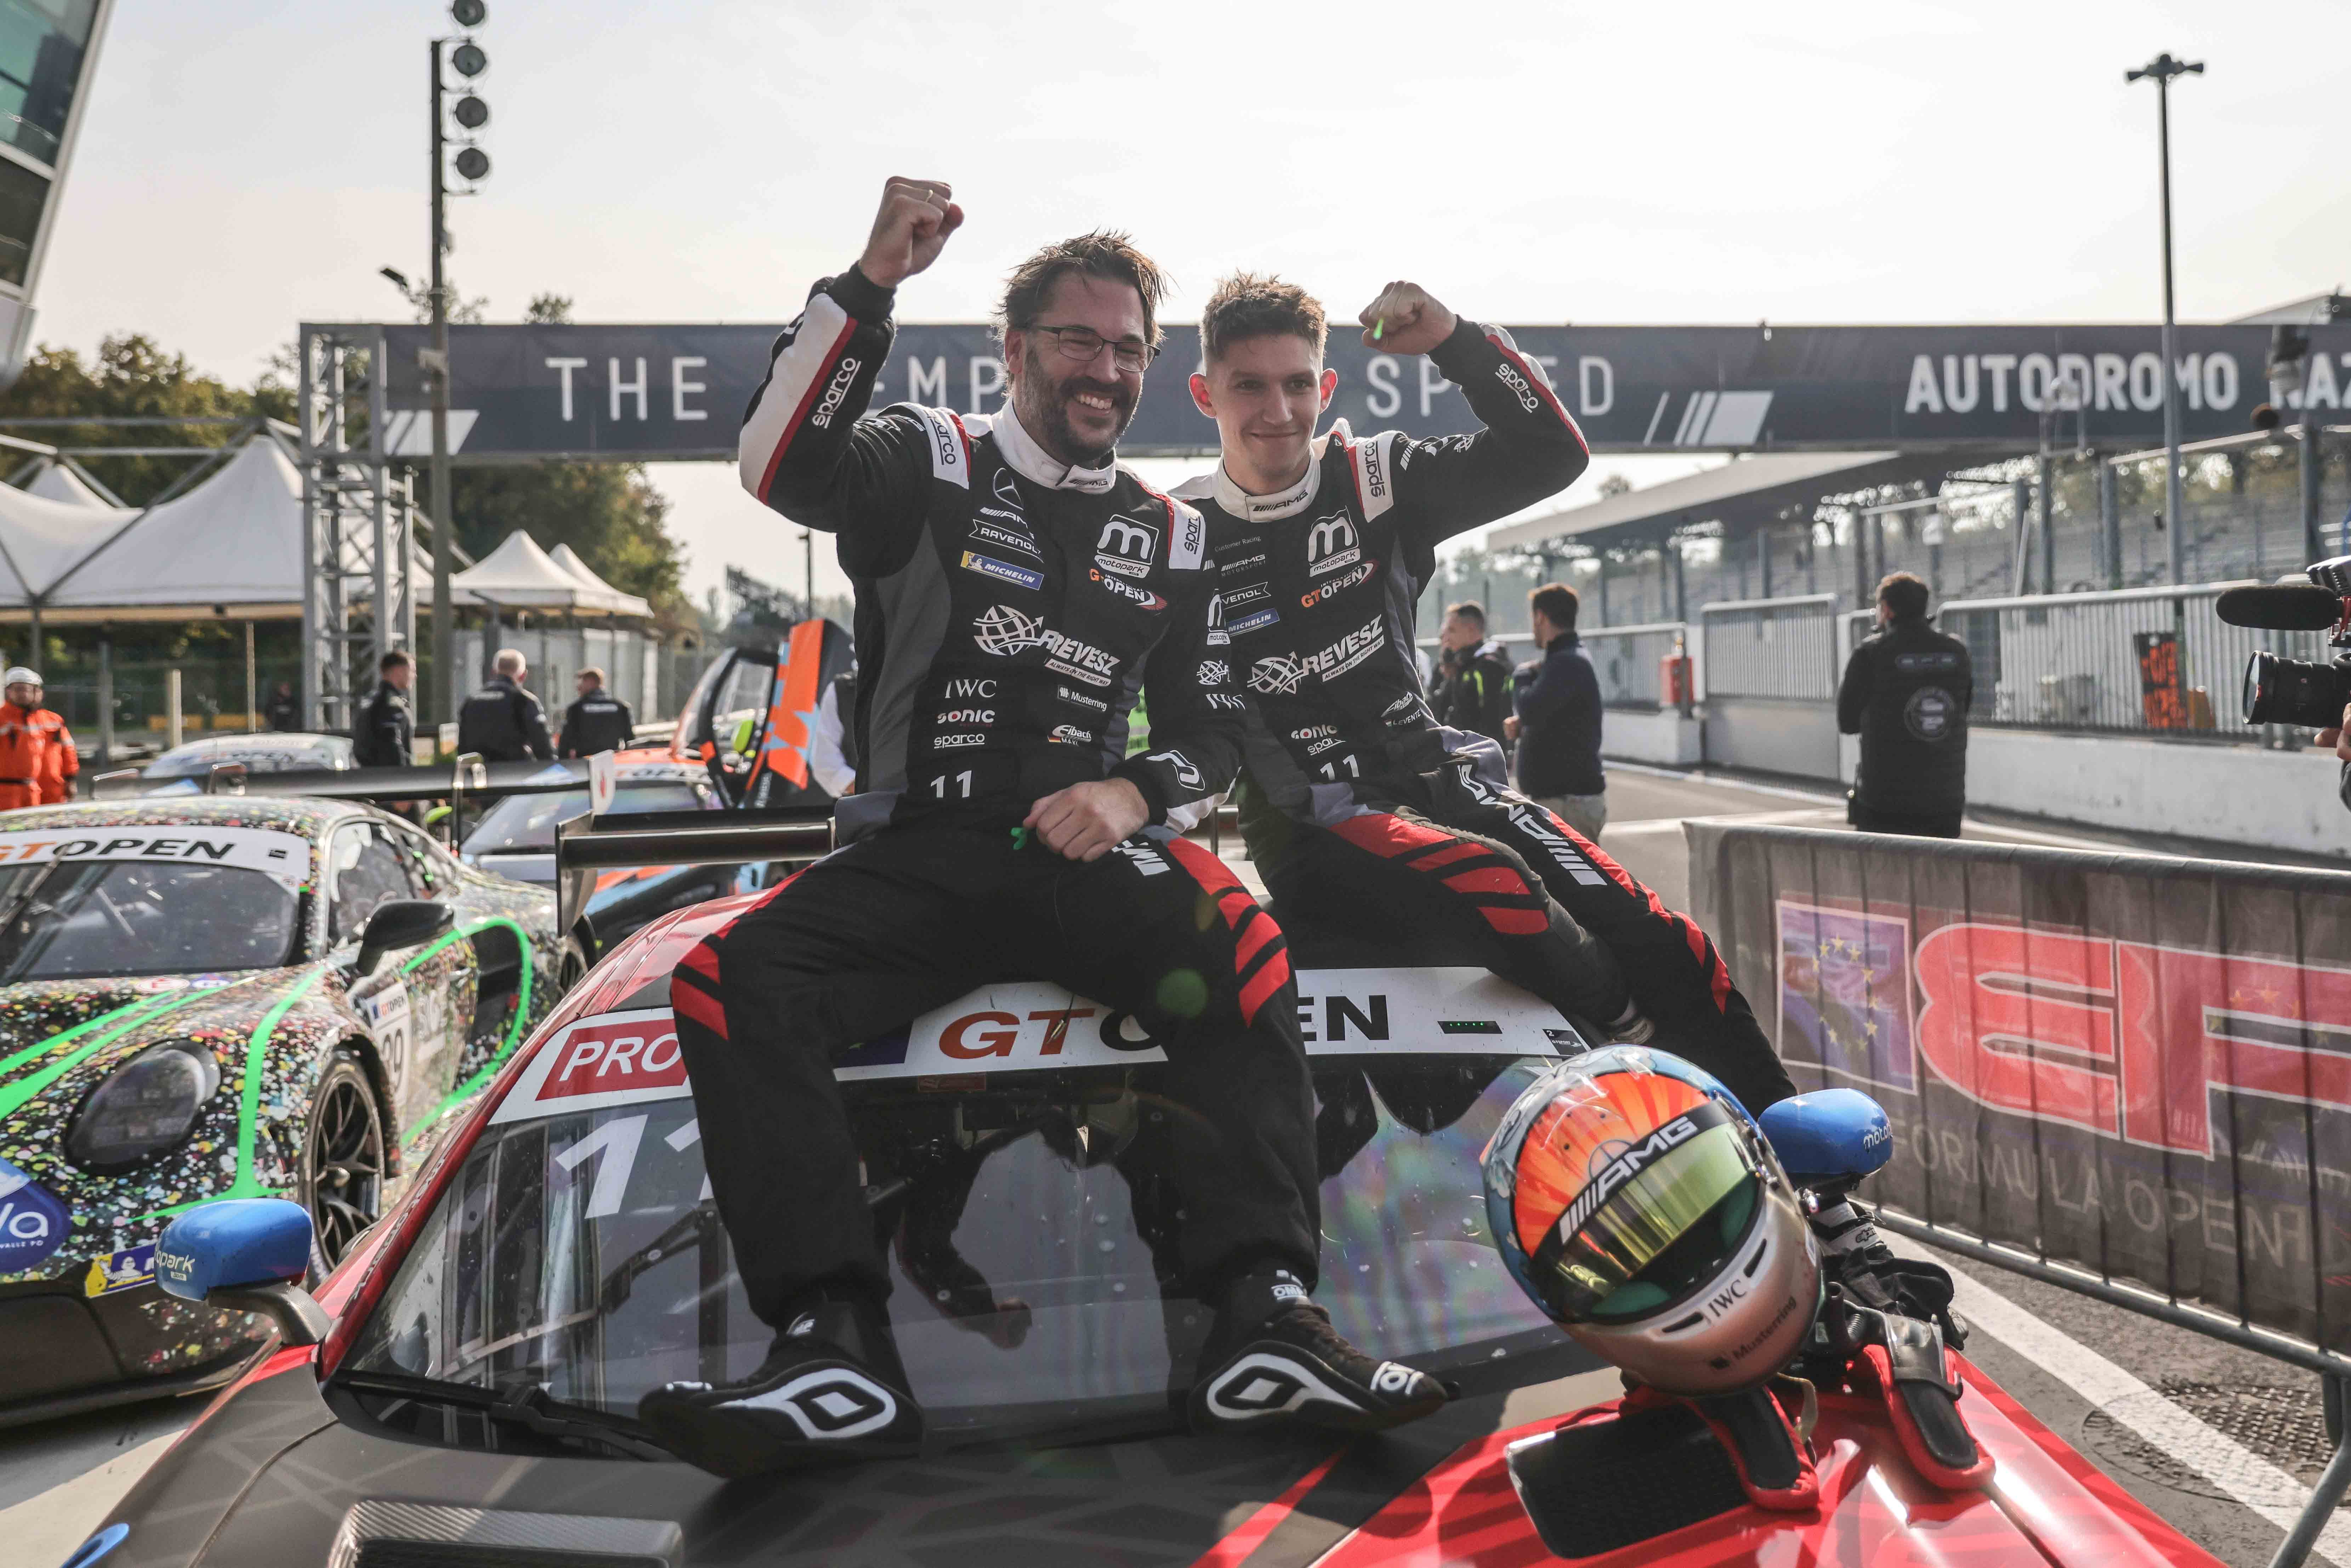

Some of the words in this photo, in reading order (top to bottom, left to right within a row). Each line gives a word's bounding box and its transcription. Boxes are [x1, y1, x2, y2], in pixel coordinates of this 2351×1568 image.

[545, 356, 709, 421] THE
[812, 358, 861, 429] sparco
[1906, 353, 2238, 413] AUTODROMO
[1364, 442, 1386, 497] sparco
[1274, 490, 1310, 510] AMG
[981, 527, 1038, 554] RAVENOL
[1184, 515, 1201, 555] spar
[1215, 541, 1241, 552] Customer
[1242, 536, 1261, 544] Racing
[984, 563, 1035, 583] MICHELIN
[1098, 558, 1145, 573] motopark
[1236, 554, 1266, 567] AMG
[1314, 551, 1356, 572] motopark
[1222, 589, 1261, 604] VENOL
[1301, 568, 1363, 608] GTOPEN
[1228, 614, 1271, 632] MICHELIN
[1042, 629, 1120, 676] REVESZ
[1302, 614, 1383, 675] REVESZ
[1324, 666, 1345, 680] ALWAYS
[1352, 655, 1361, 664] THE
[1360, 646, 1373, 659] RIGHT
[1373, 639, 1383, 651] WAY
[1049, 661, 1070, 672] ALWAYS
[1099, 677, 1109, 686] WAY
[945, 678, 996, 699] IWC
[1071, 691, 1107, 712] Musterring
[1393, 709, 1421, 725] LEVENTE
[934, 733, 985, 749] sparco
[1052, 725, 1092, 739] Eibach
[1307, 738, 1342, 756] spar
[1320, 754, 1359, 780] 11
[930, 770, 972, 798] 11
[558, 1032, 682, 1082] PRO
[1597, 1116, 1697, 1201] AMG
[1708, 1279, 1747, 1318] IWC
[1733, 1295, 1796, 1360] Musterring
